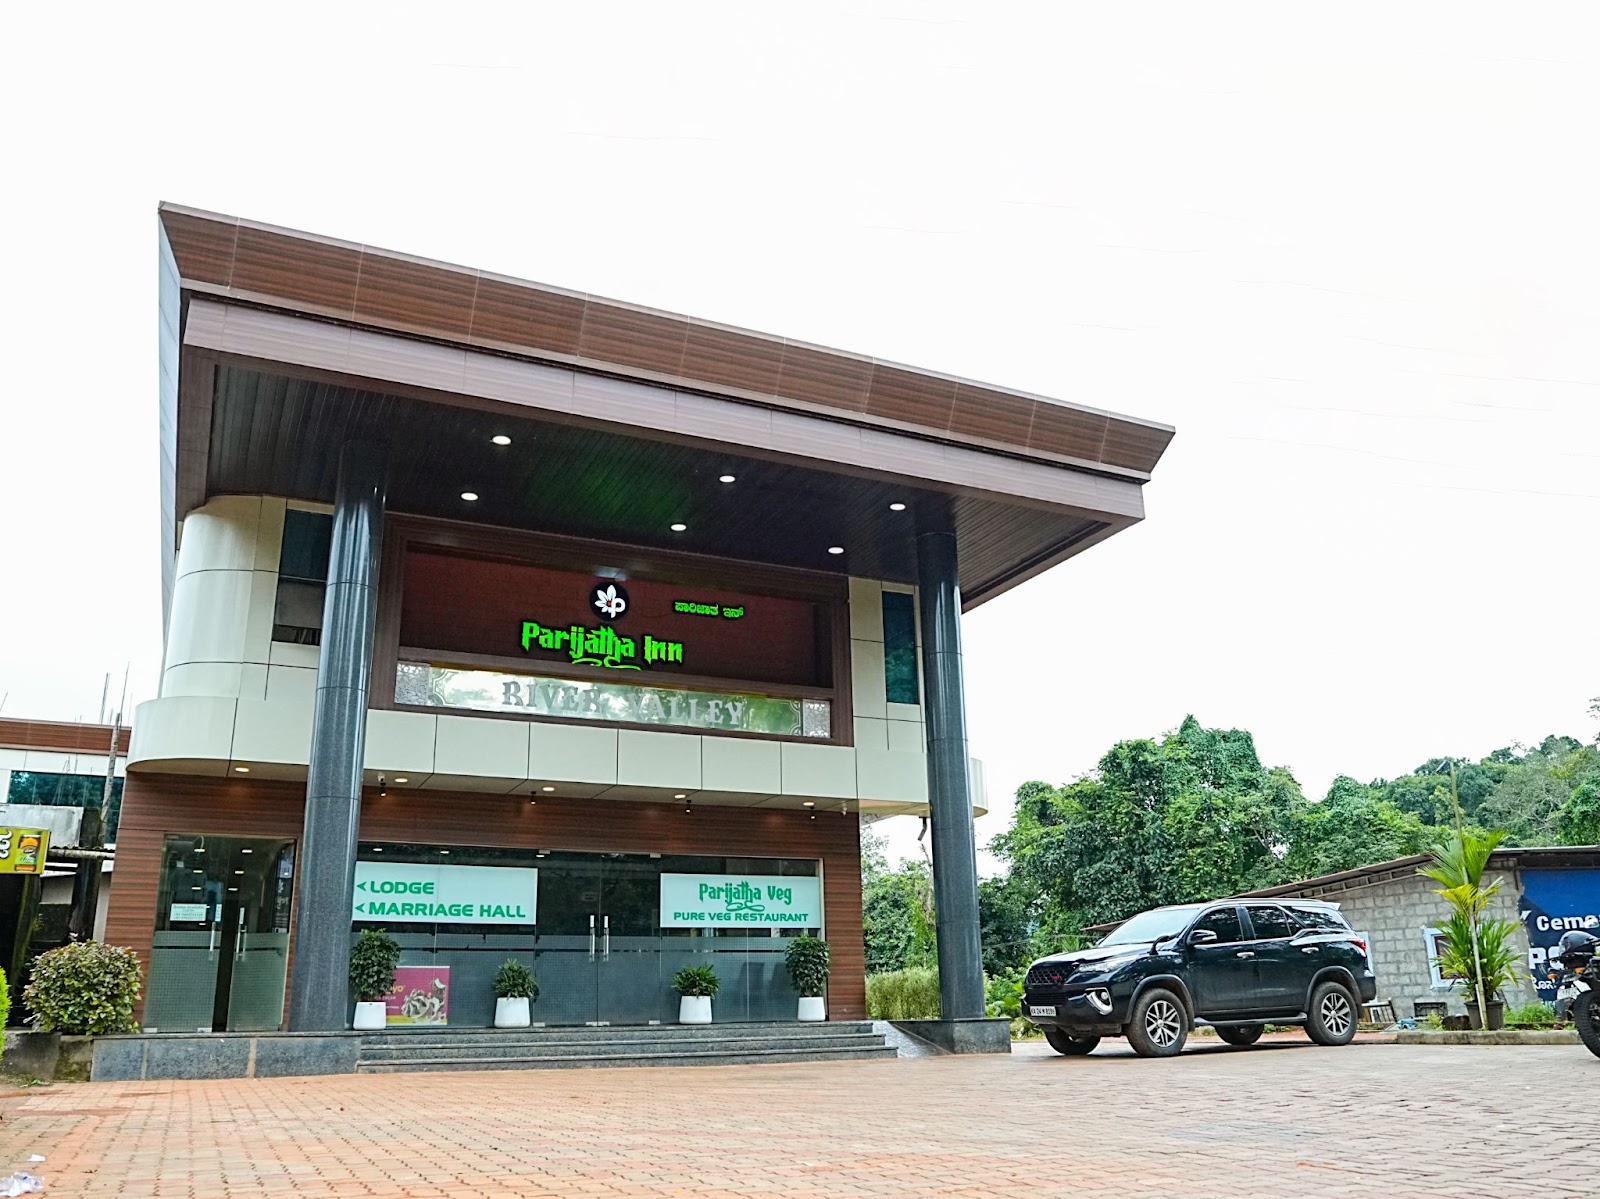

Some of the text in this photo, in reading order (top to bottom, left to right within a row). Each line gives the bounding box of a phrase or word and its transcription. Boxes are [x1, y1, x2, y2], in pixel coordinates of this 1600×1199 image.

[521, 621, 683, 665] Parijatha Inn
[501, 680, 744, 725] RIVER VALLEY
[370, 880, 434, 895] LODGE
[699, 881, 792, 905] Parijatha Veg
[368, 902, 526, 918] MARRIAGE HALL
[673, 911, 809, 922] PURE VEG RESTAURANT
